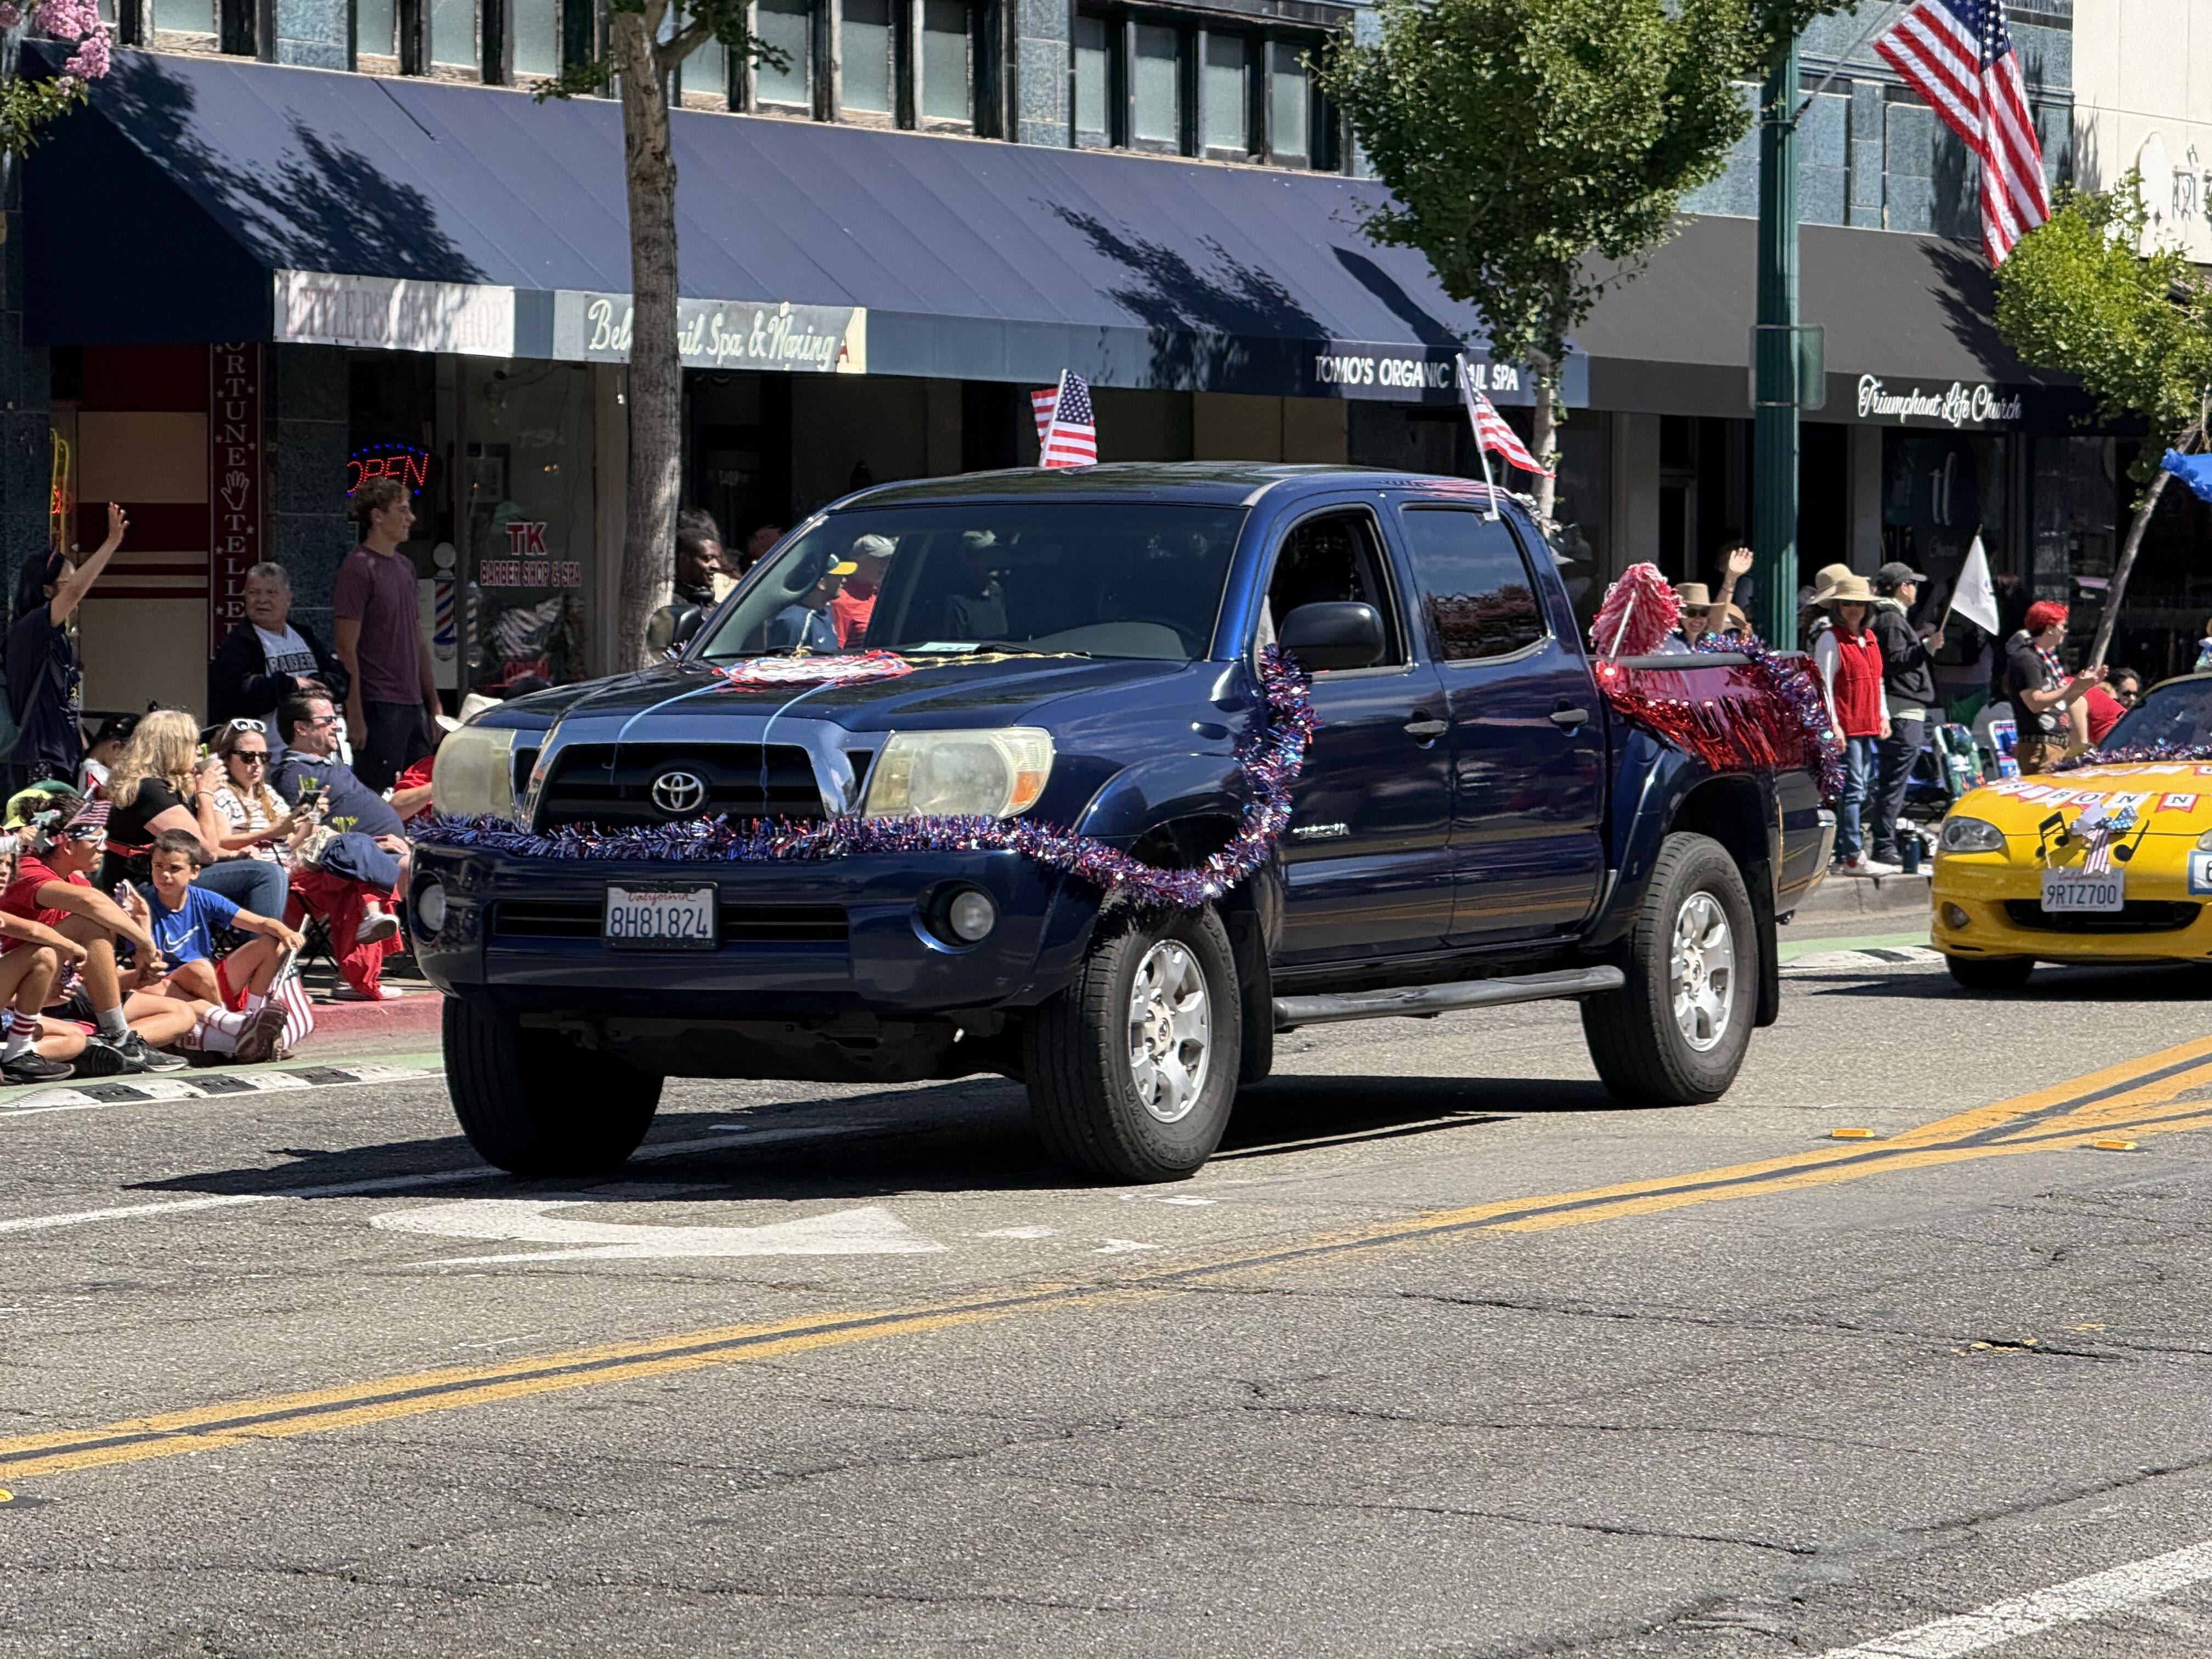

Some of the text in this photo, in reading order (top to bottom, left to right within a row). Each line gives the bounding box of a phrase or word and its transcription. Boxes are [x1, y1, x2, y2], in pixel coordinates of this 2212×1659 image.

[456, 300, 503, 349] HOP
[706, 313, 743, 365] Spa
[748, 310, 766, 357] &
[767, 314, 837, 372] Waxing
[1315, 356, 1374, 385] TOMO'S
[1379, 358, 1449, 388] ORGANIC
[1492, 364, 1519, 391] SPA
[1858, 374, 2022, 428] Triumphant Life Church
[505, 522, 548, 556] TK
[480, 560, 581, 587] BARBER SHOP & SPA
[267, 652, 319, 673] RAIDER
[2046, 884, 2117, 905] 9RTZ700
[610, 907, 708, 938] 8H81824
